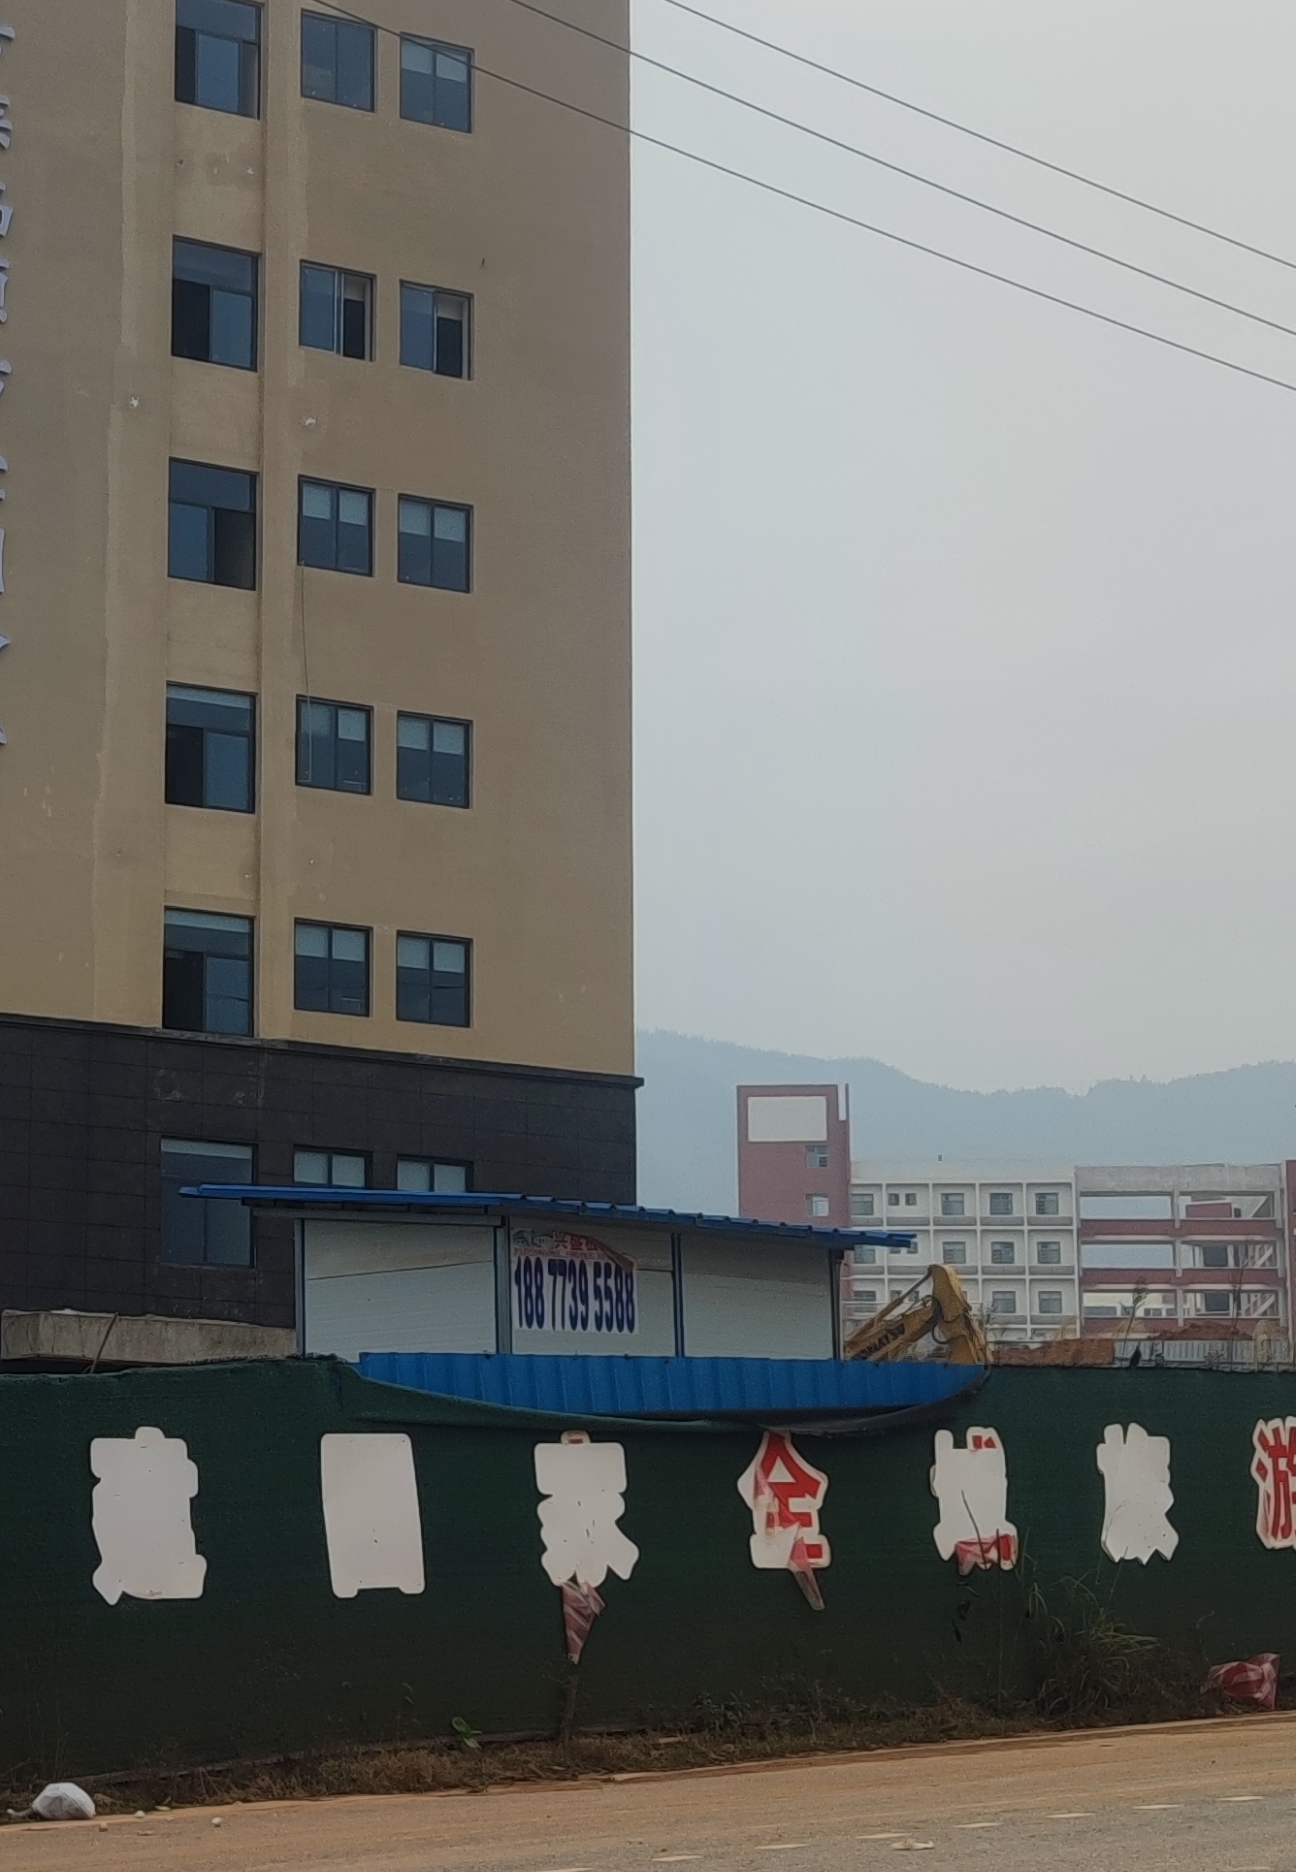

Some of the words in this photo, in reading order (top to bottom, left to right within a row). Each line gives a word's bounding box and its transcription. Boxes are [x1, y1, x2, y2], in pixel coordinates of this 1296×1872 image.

[515, 1256, 545, 1329] 188
[548, 1259, 589, 1331] 7739
[594, 1261, 635, 1333] 5588
